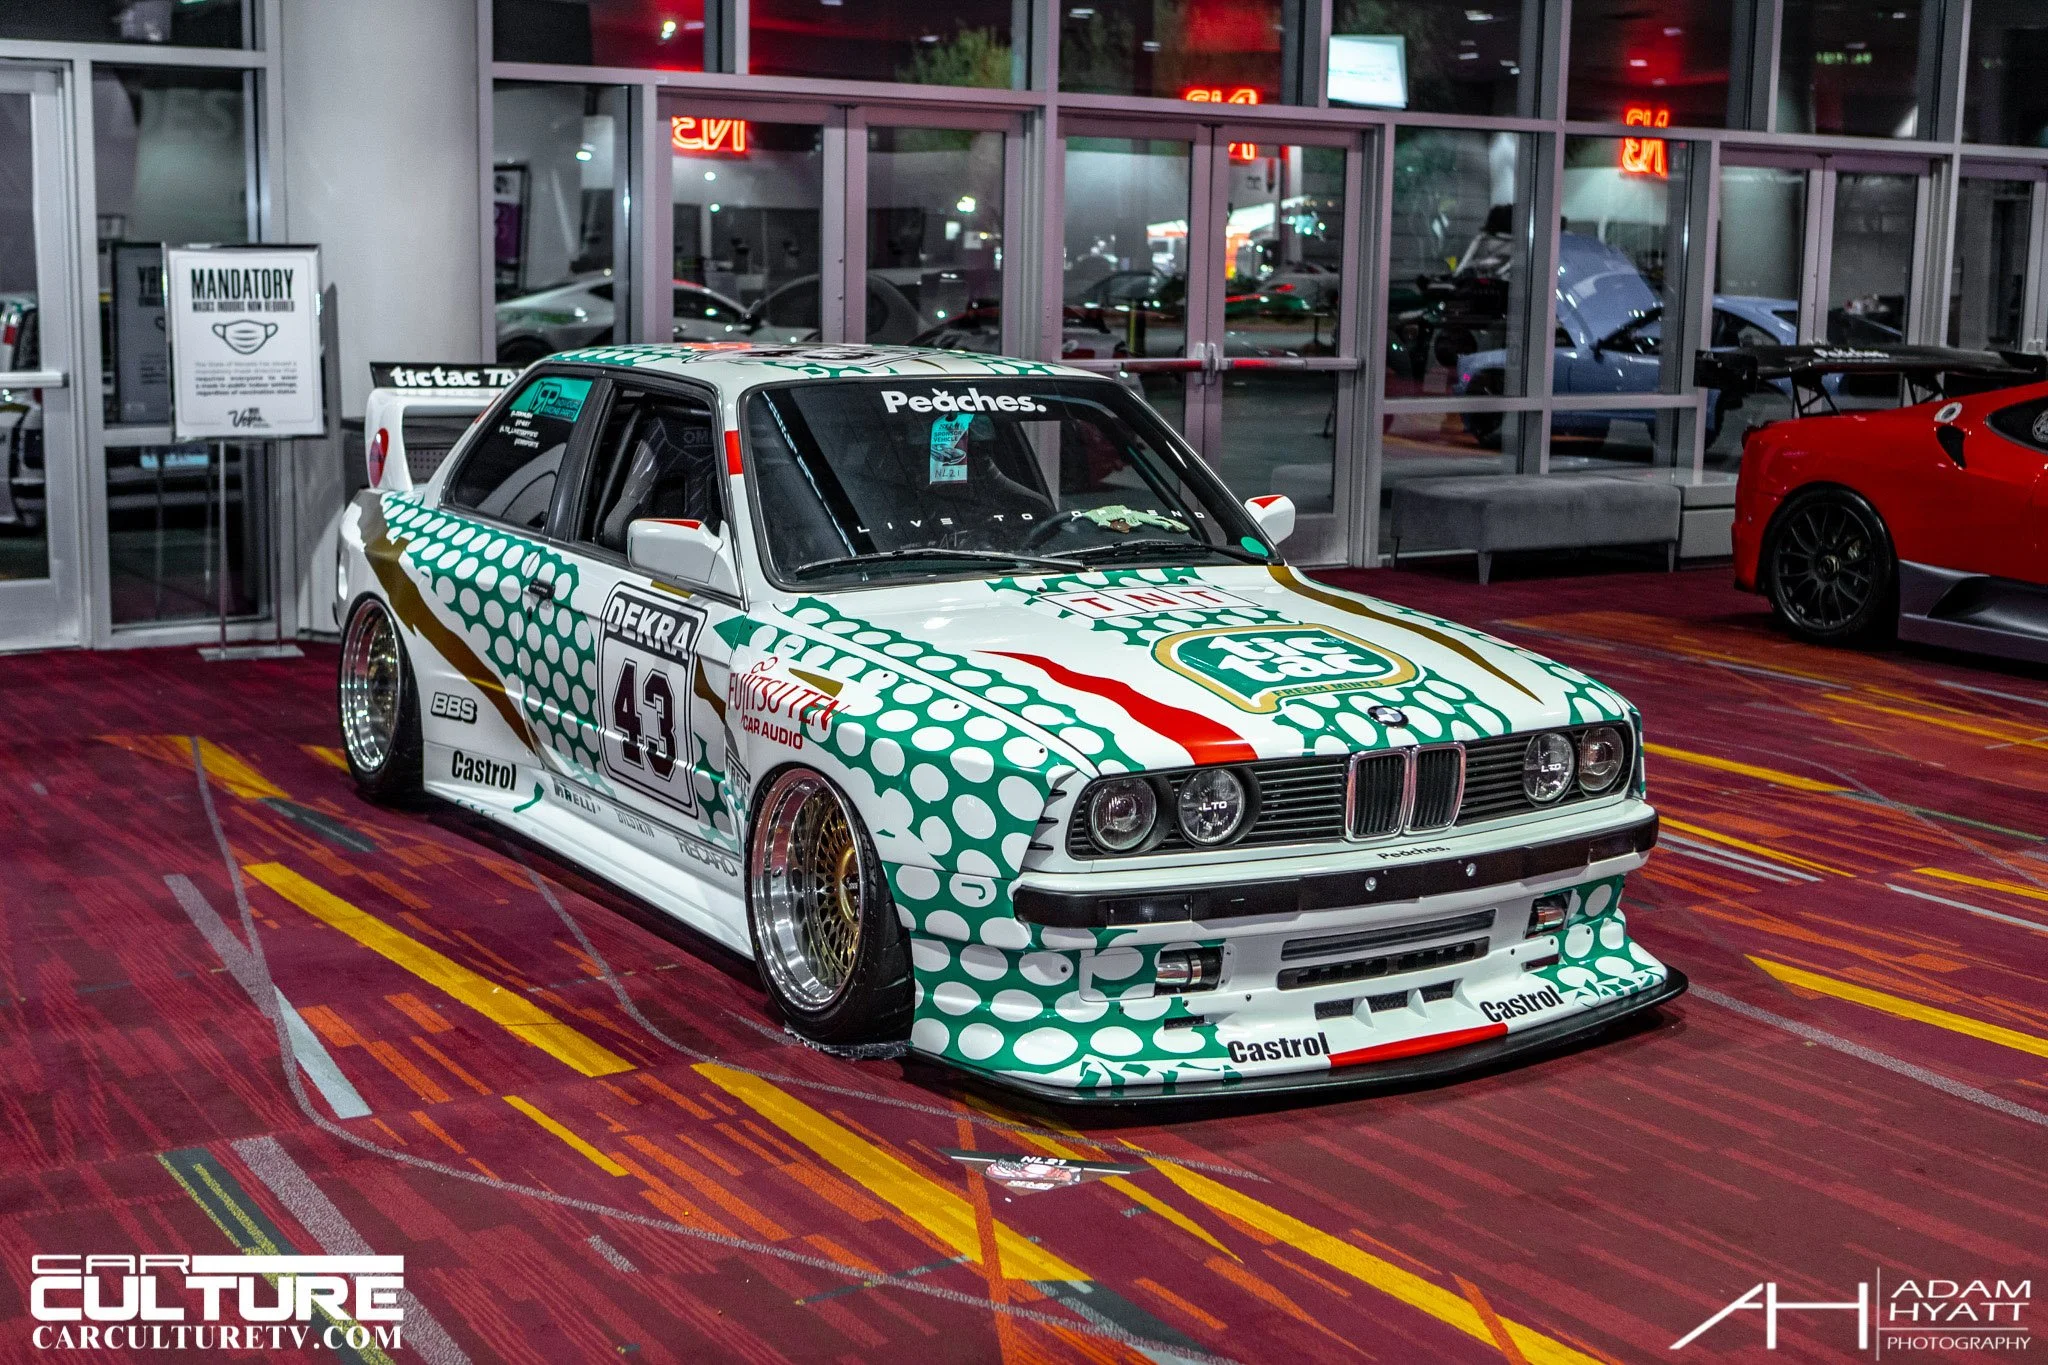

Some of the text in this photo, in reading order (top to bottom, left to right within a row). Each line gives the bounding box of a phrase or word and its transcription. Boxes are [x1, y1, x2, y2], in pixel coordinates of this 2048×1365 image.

[191, 268, 294, 300] MANDATORY
[390, 366, 526, 387] tictac TA
[881, 387, 1047, 413] Peaches.
[857, 517, 953, 533] LIVE
[993, 513, 1034, 521] TO
[1071, 591, 1224, 612] TNT
[606, 596, 692, 660] DEKRA
[1208, 635, 1346, 661] tic
[1218, 653, 1386, 683] tac
[1272, 680, 1384, 698] FRESH MINTS
[431, 692, 478, 723] BBS
[612, 658, 677, 782] 43
[743, 715, 804, 750] CAR AUDIO
[451, 751, 517, 791] Castrol
[1479, 985, 1564, 1023] Castrol
[1228, 1031, 1331, 1064] Castrol
